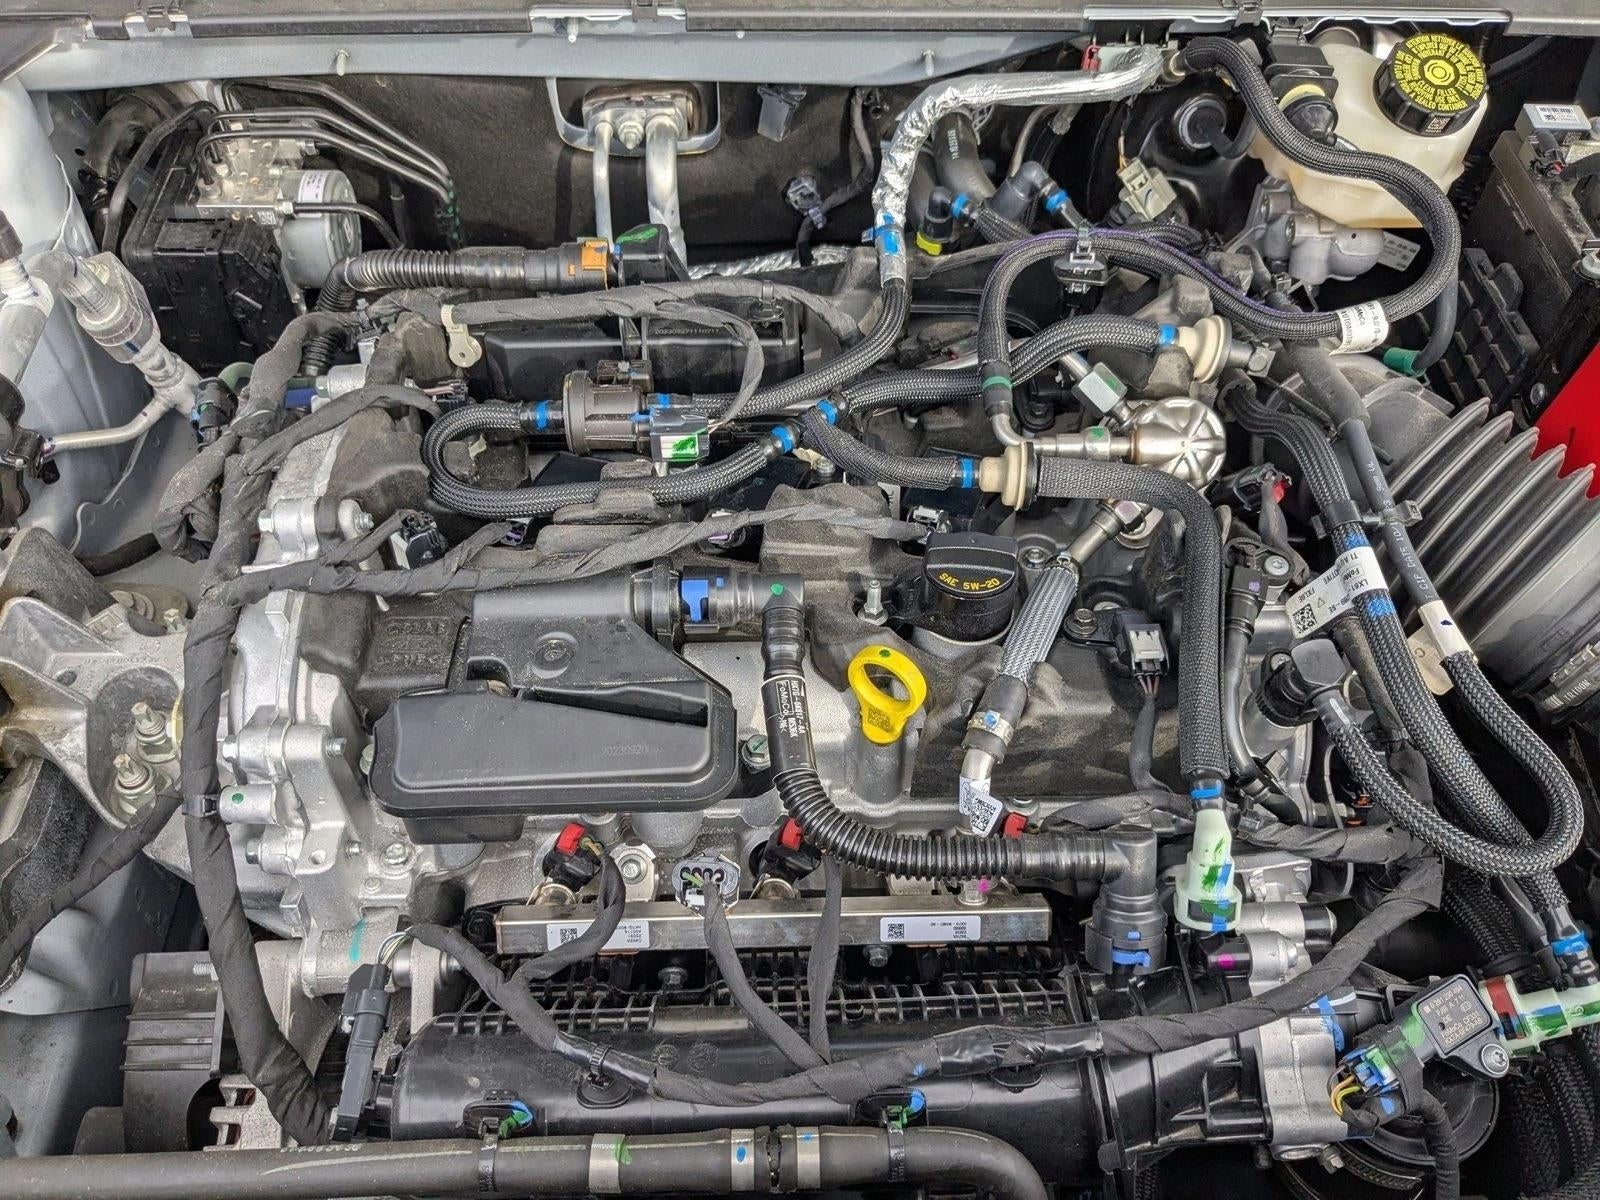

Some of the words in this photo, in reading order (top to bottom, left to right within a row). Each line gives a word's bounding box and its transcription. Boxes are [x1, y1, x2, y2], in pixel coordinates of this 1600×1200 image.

[1350, 552, 1359, 560] TI
[1400, 546, 1416, 568] DATE
[940, 572, 959, 587] SAE
[963, 578, 1000, 591] 5W-20
[779, 681, 790, 715] FoMoCo
[1562, 678, 1592, 701] TRIDON
